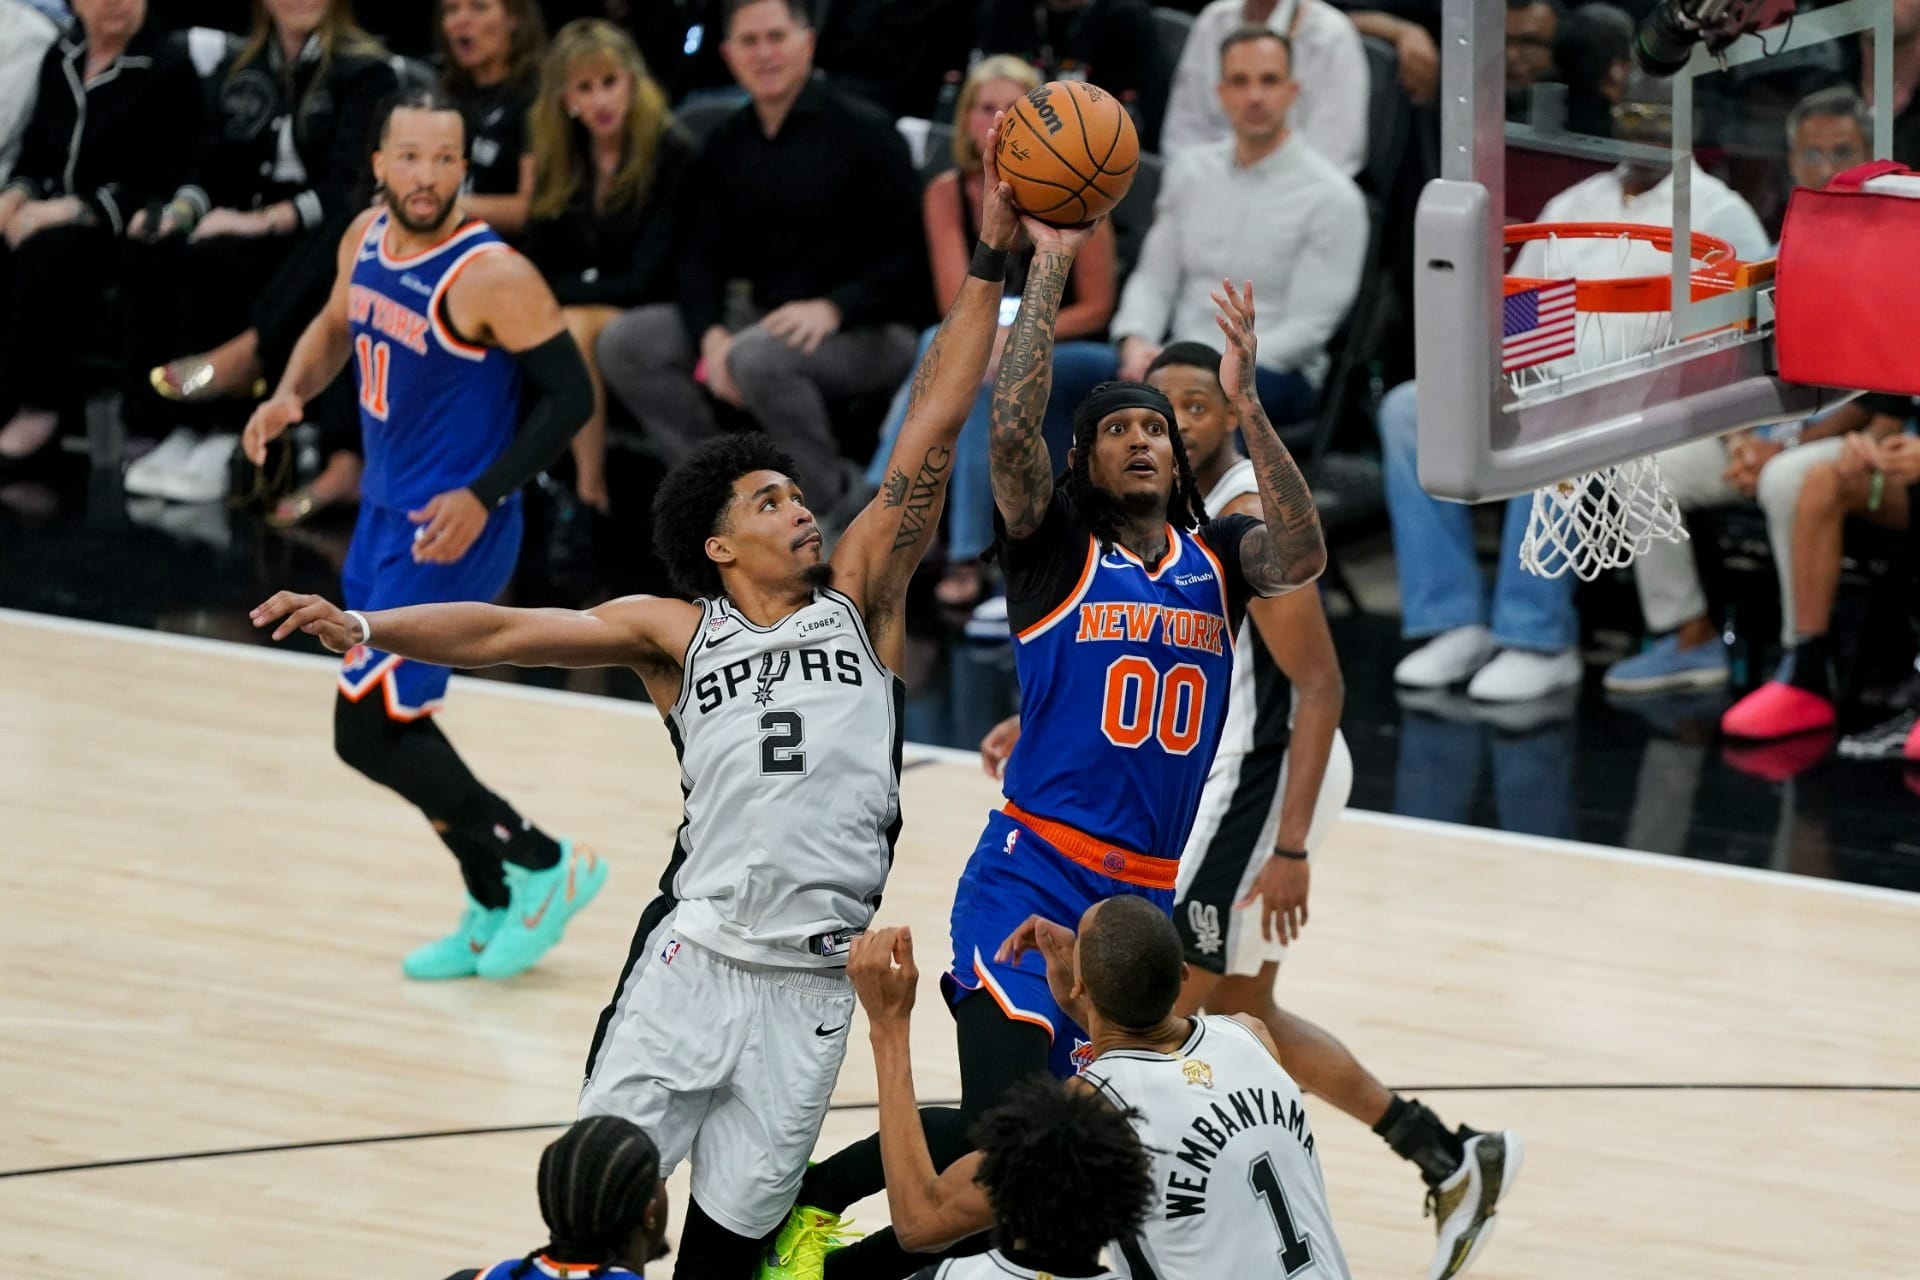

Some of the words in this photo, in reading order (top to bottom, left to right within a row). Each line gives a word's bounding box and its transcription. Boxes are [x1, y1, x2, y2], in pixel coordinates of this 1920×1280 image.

[1025, 84, 1063, 135] ilson
[355, 333, 391, 423] 11
[891, 444, 949, 553] WAWG
[803, 618, 835, 632] LEDGER
[1075, 602, 1163, 643] NEW
[1160, 607, 1224, 657] YORK
[695, 649, 863, 715] SPURS
[1100, 655, 1208, 756] 00
[757, 709, 806, 776] 2
[1166, 1087, 1315, 1220] WEMBANYAMA
[1248, 1151, 1316, 1279] 1
